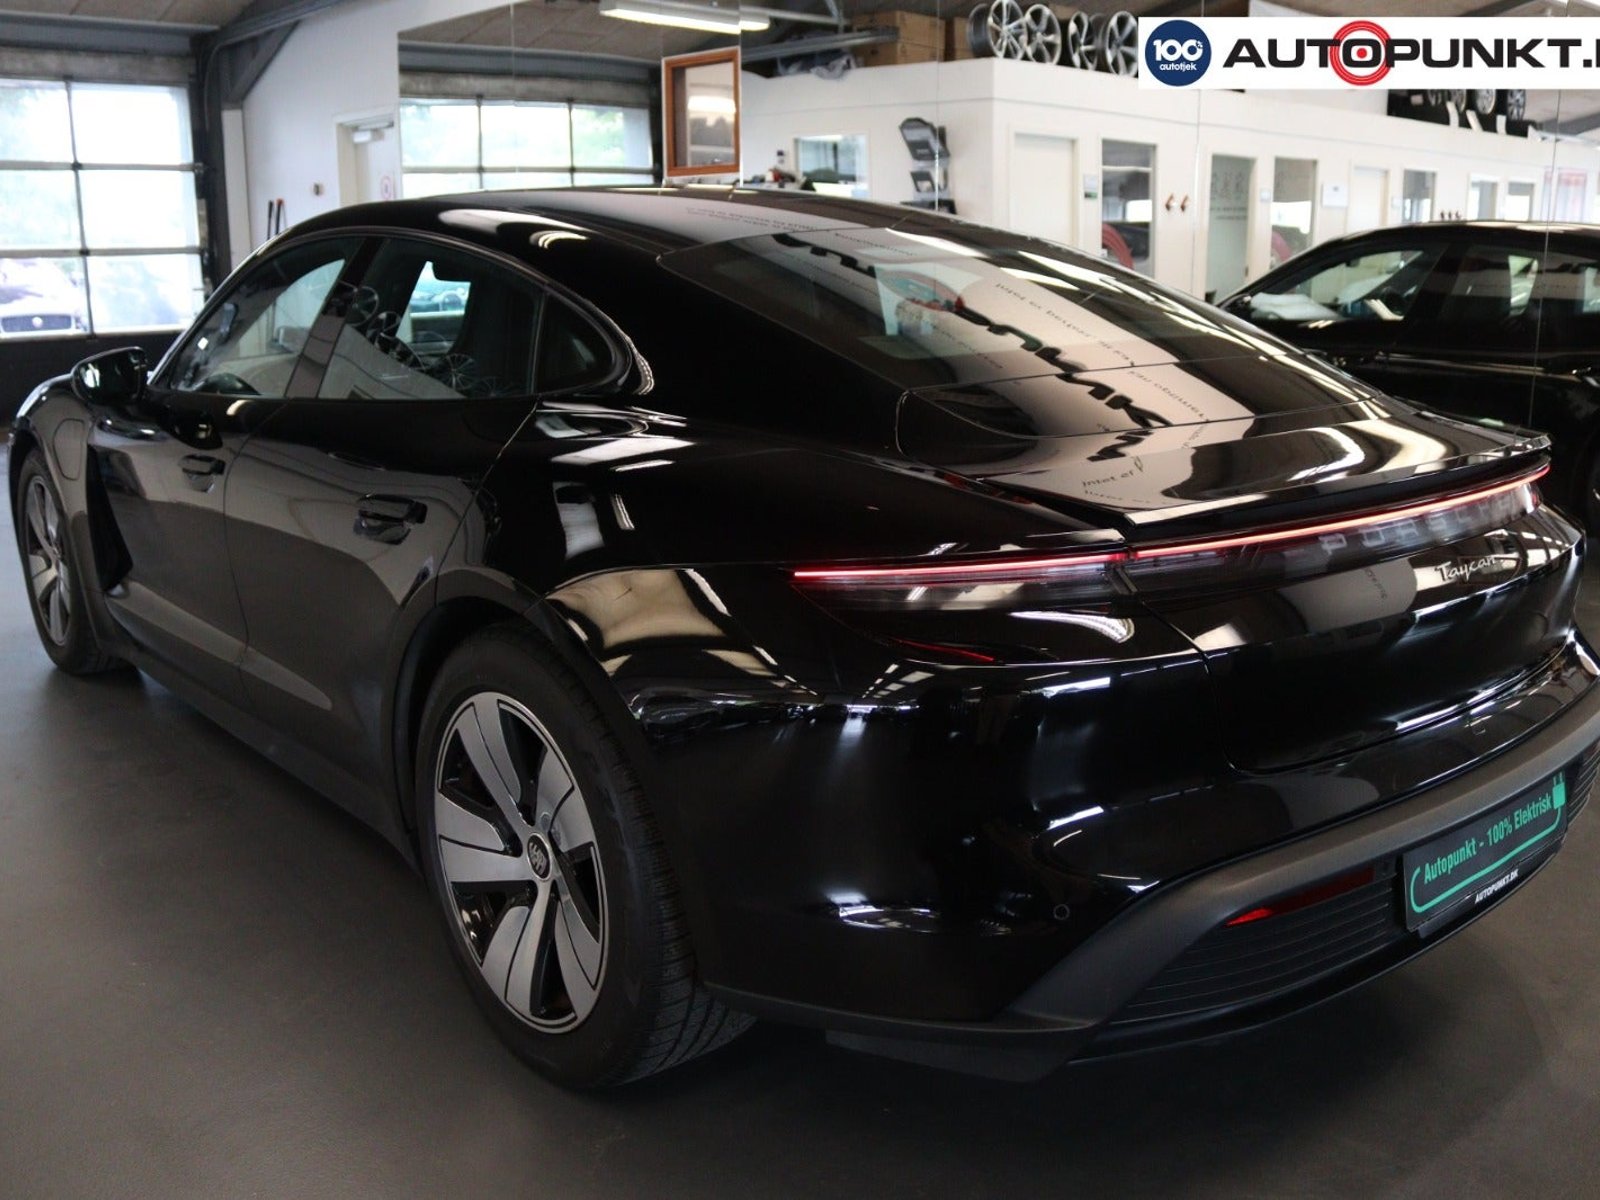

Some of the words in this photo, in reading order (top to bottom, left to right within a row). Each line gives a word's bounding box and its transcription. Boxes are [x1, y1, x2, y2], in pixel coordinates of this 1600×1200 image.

[1435, 556, 1495, 582] Taycan
[1424, 838, 1477, 884] Autopunkt
[1486, 816, 1513, 846] 100%
[1513, 793, 1552, 829] Elektrisk
[1475, 868, 1519, 904] AUTOPUNKT.DK
